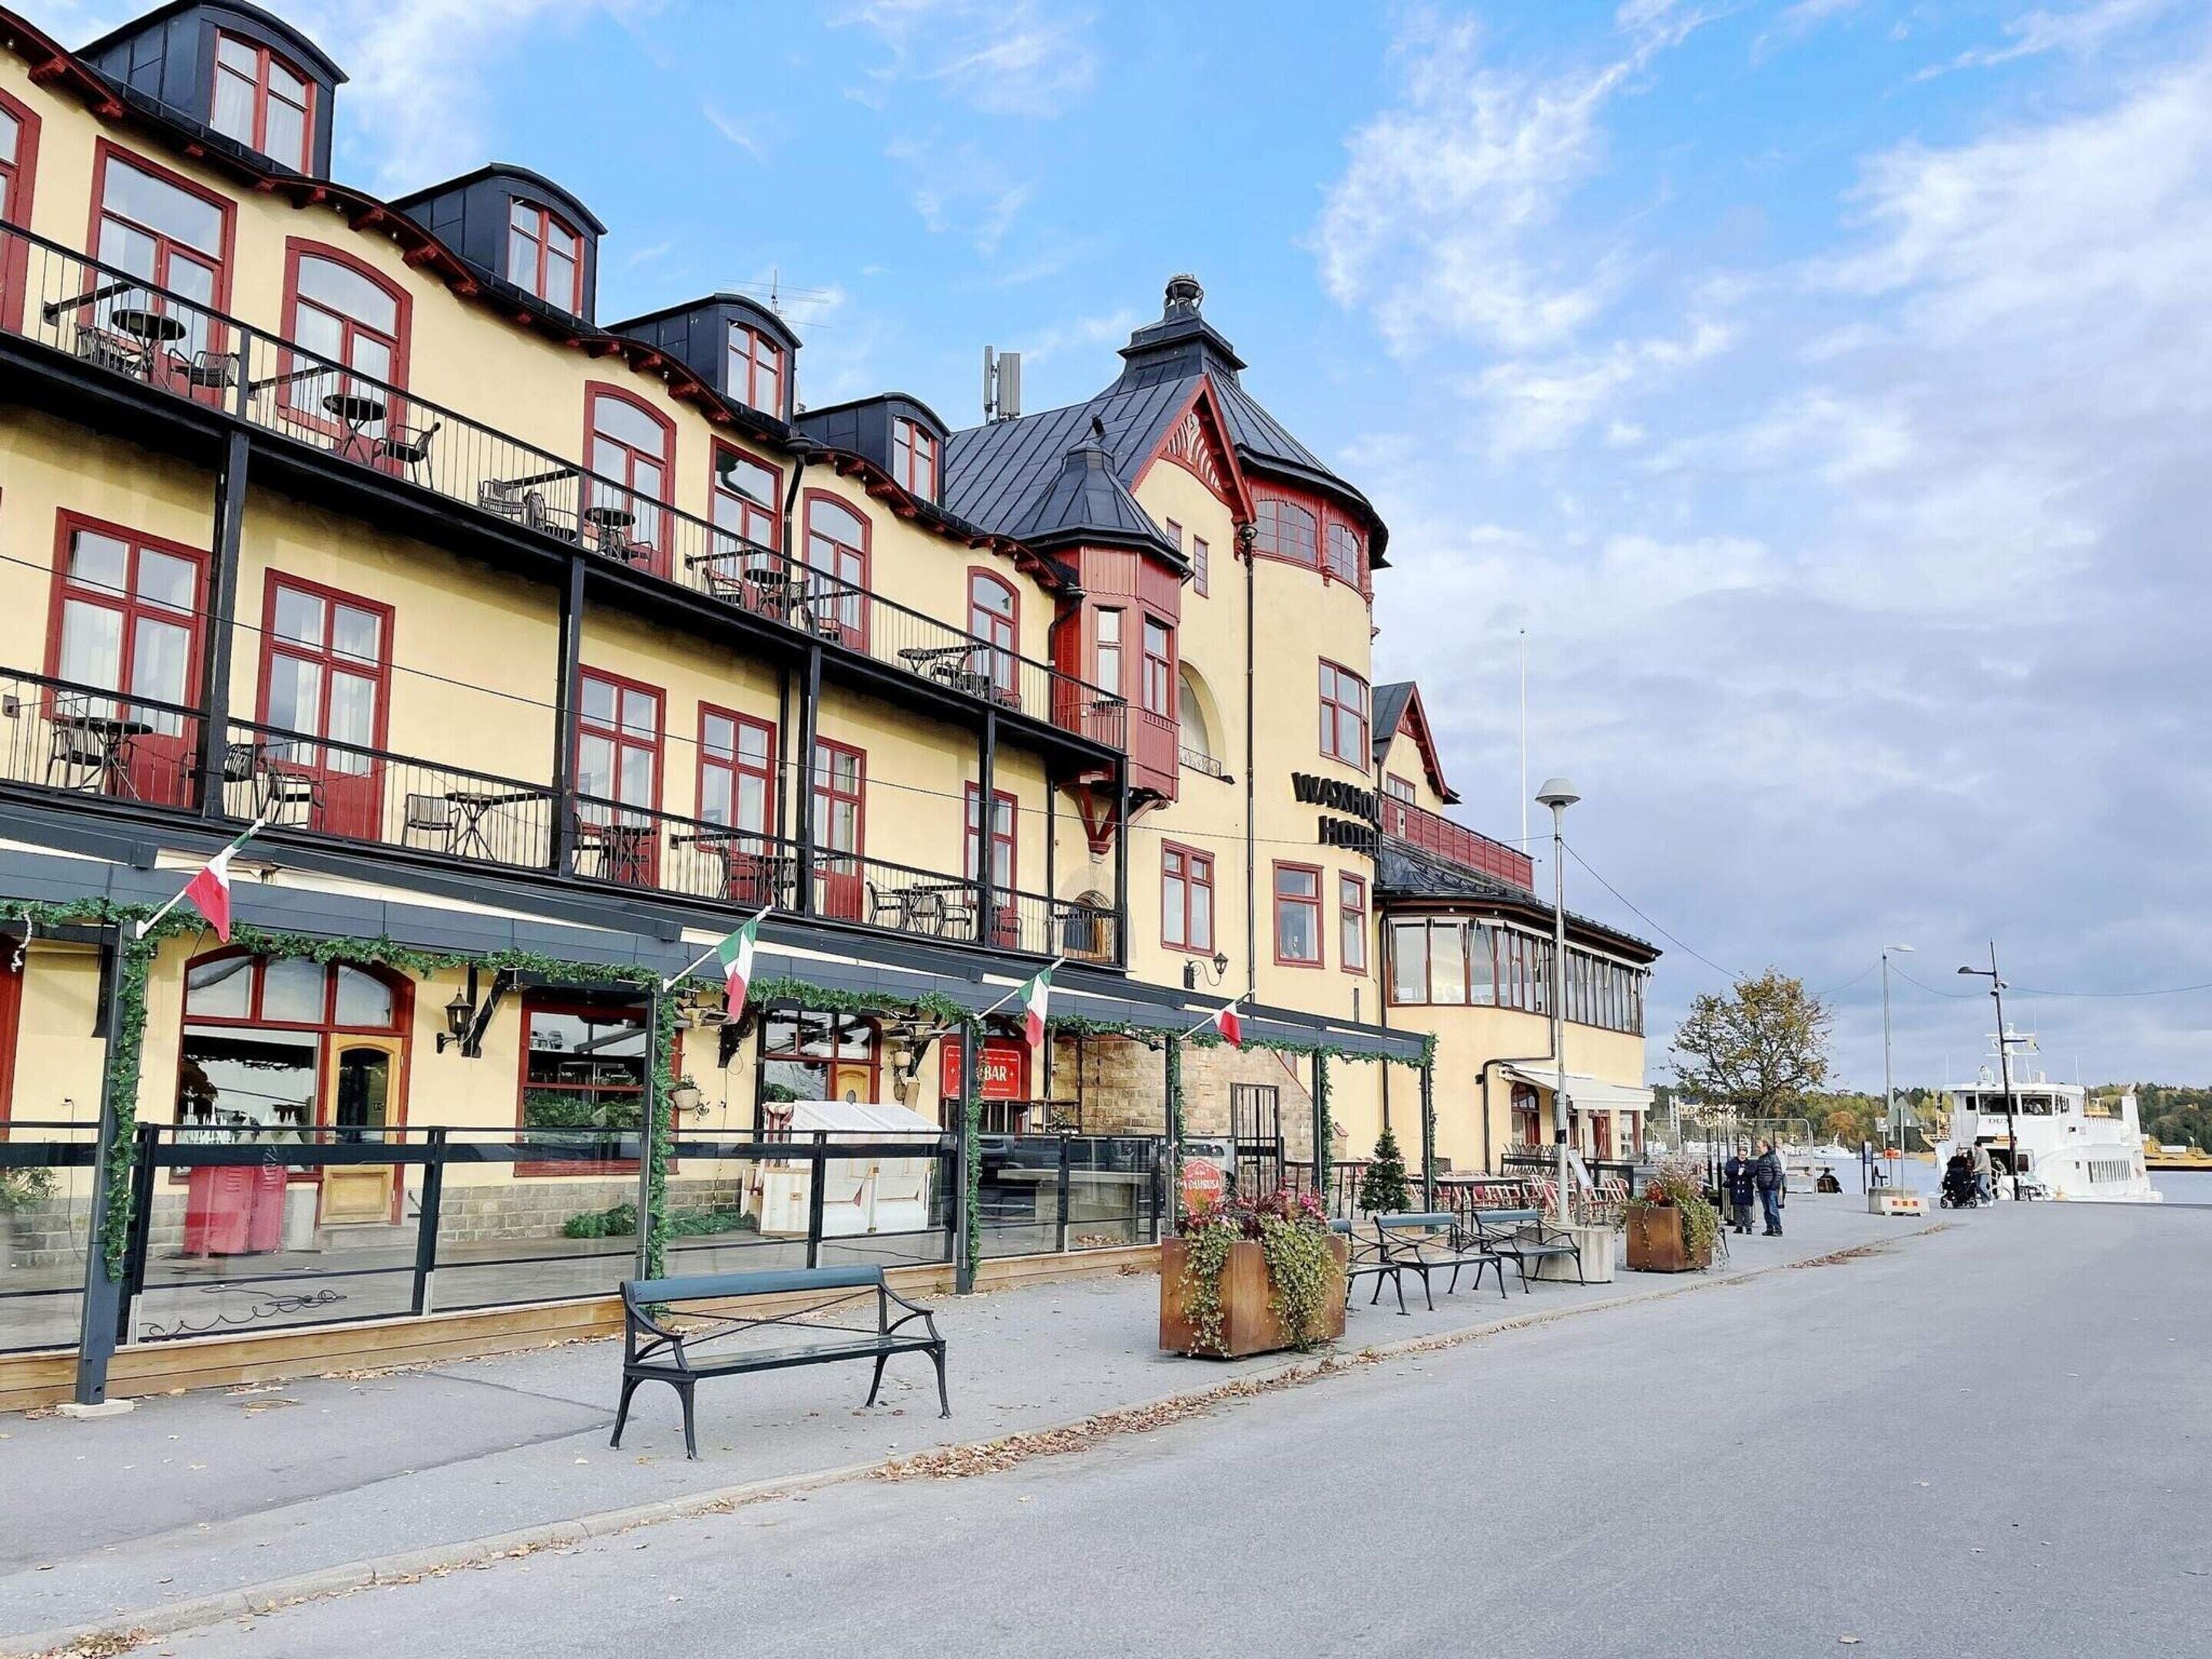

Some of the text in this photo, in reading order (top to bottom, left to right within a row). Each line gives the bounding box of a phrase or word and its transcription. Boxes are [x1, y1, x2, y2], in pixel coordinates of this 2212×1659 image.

[1291, 772, 1382, 833] WAXHOL
[1318, 816, 1383, 860] HOTEL
[985, 1065, 1008, 1081] BAR
